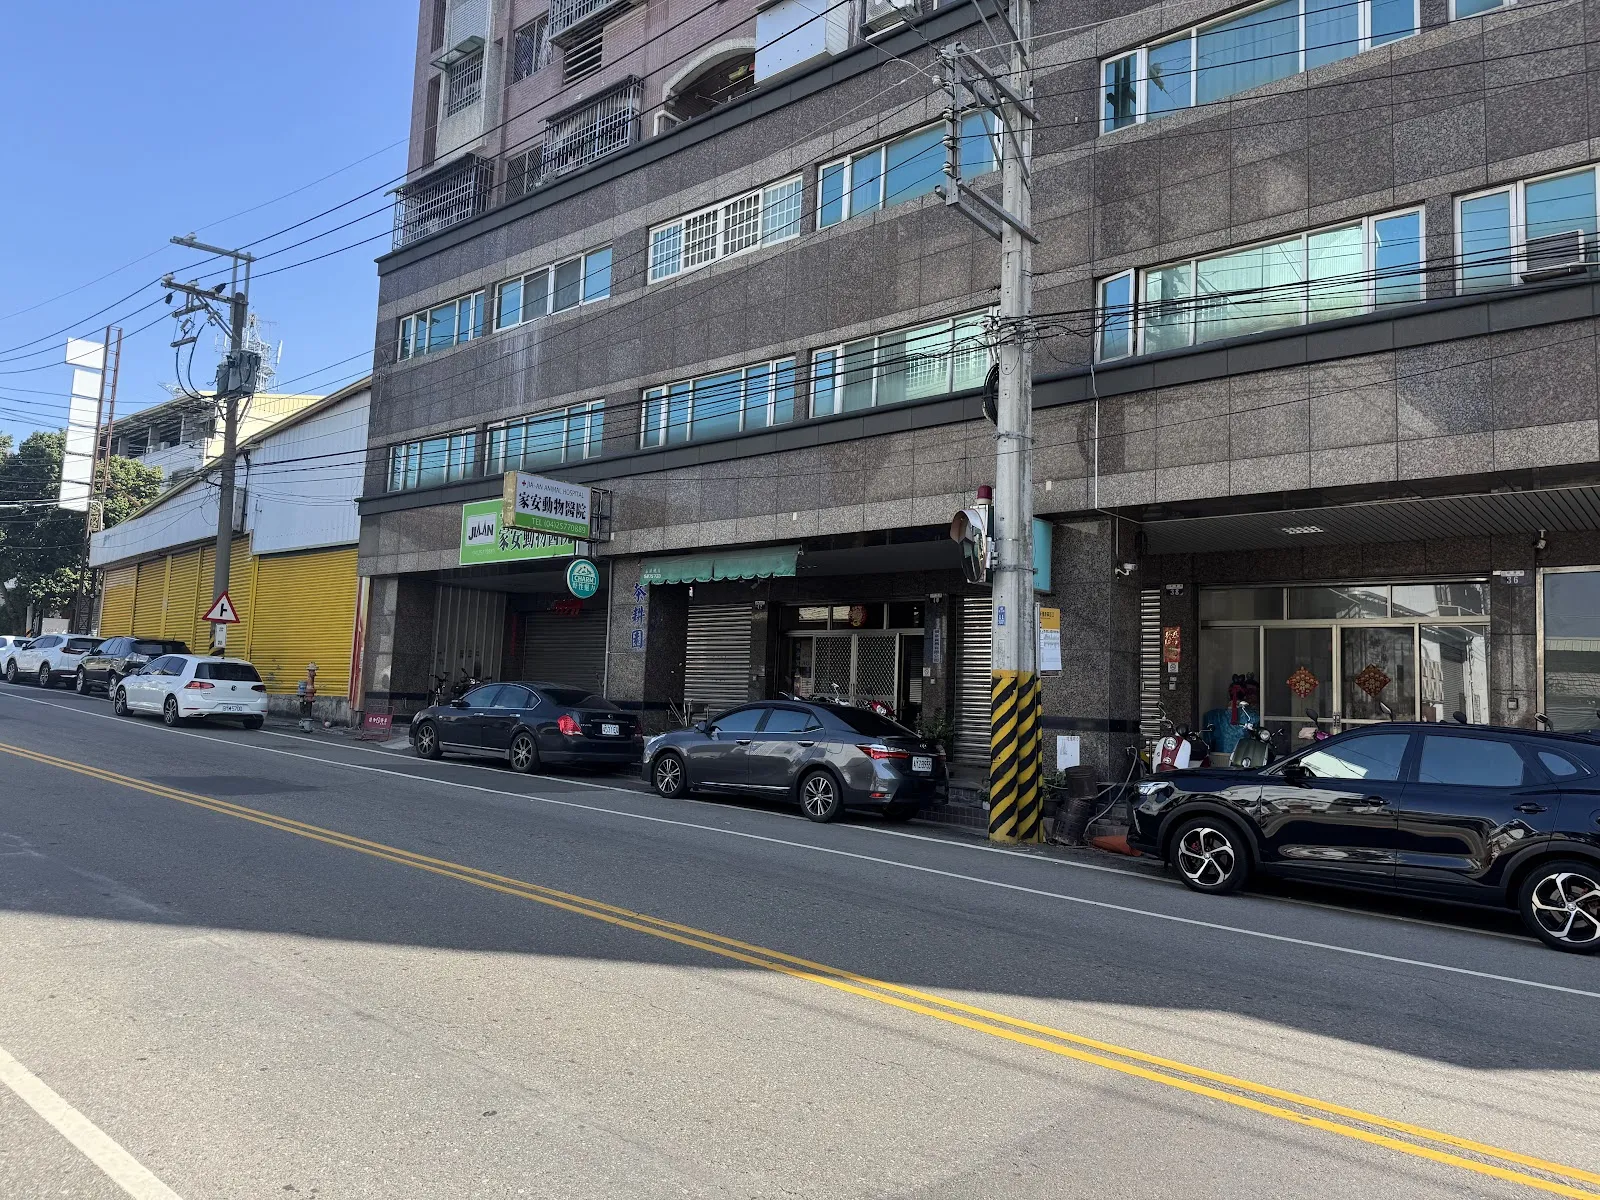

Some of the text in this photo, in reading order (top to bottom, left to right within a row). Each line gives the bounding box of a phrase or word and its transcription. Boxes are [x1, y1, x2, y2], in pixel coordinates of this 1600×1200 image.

[544, 485, 562, 495] ANIMAL
[562, 489, 584, 499] HOSPITAL
[518, 491, 587, 520] 家安動物醫院
[532, 517, 543, 527] TEL
[573, 575, 595, 584] CHARM
[1506, 576, 1519, 585] 36
